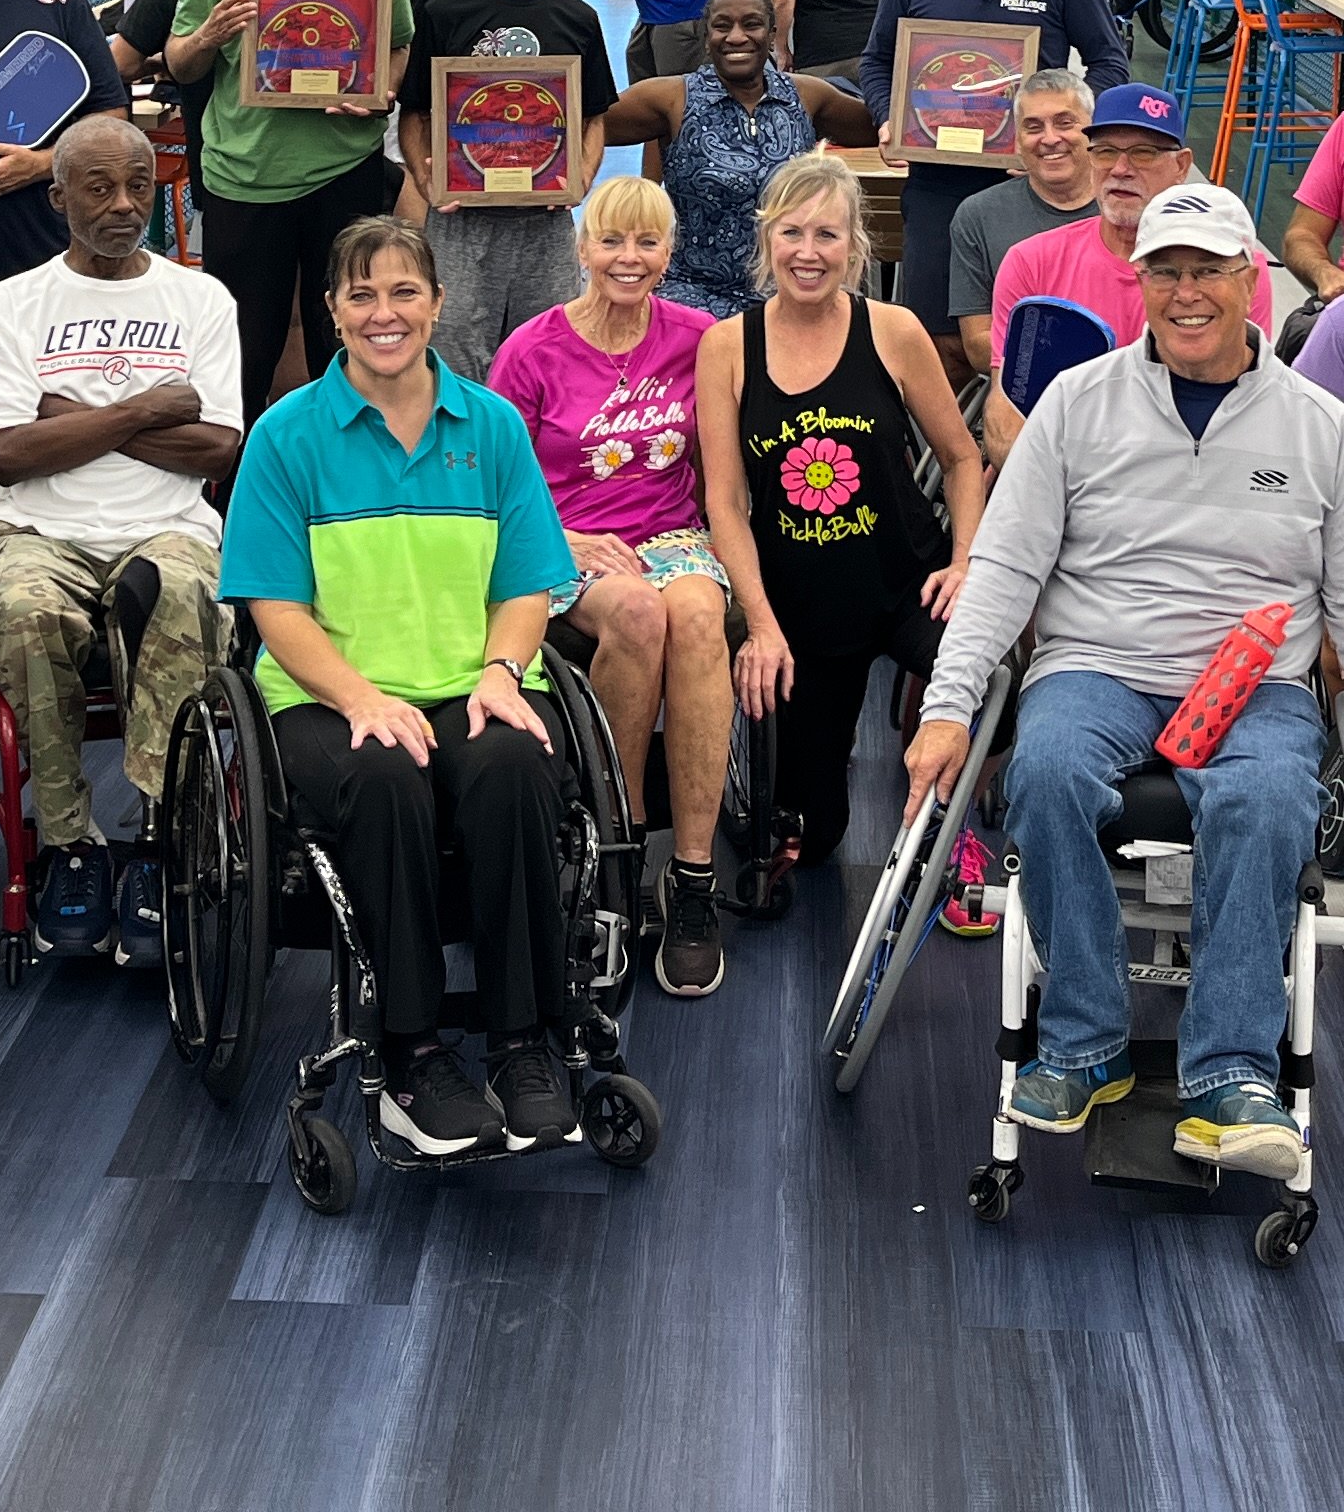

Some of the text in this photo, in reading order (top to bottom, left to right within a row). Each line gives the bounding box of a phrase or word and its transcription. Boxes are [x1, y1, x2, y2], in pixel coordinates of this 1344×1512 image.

[44, 319, 182, 355] LET'S ROLL
[39, 356, 186, 370] PICKLEBALL ROCKS
[600, 377, 673, 411] Rollin'
[579, 401, 686, 441] PickleBelle
[748, 406, 875, 457] I'm A Bloomin'
[777, 504, 878, 546] PickleBelle
